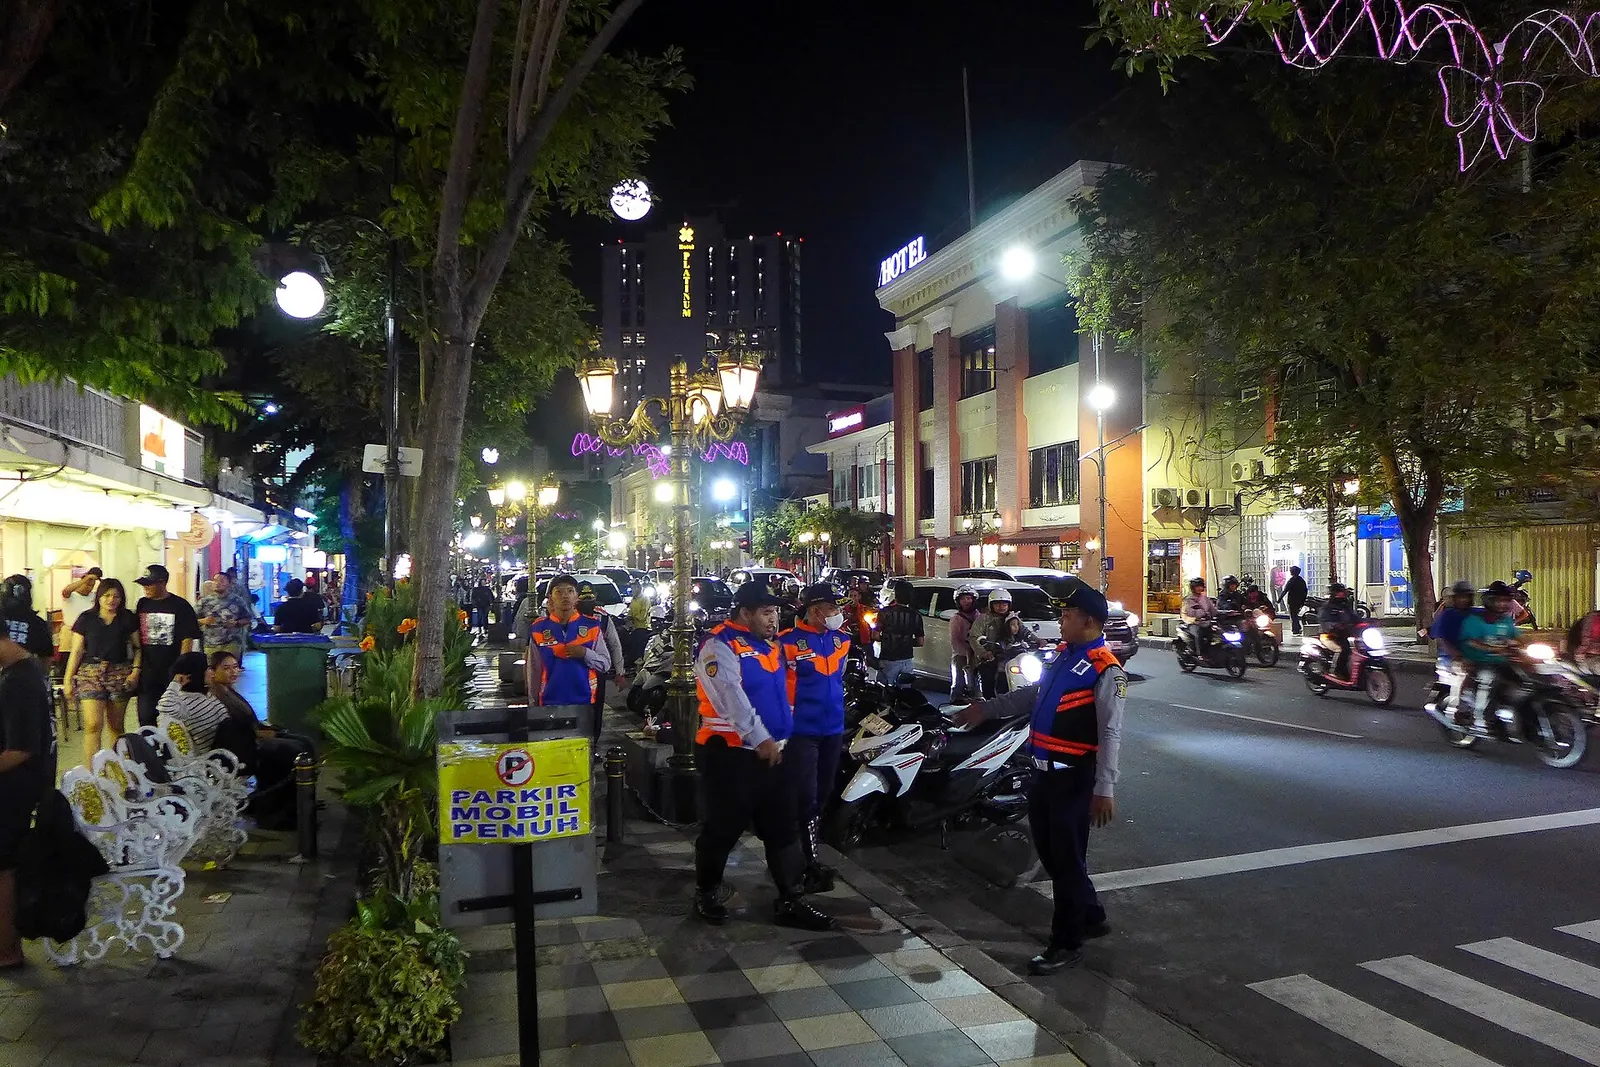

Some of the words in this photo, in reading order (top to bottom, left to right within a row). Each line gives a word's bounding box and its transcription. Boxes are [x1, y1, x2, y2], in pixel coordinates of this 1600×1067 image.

[881, 236, 927, 285] HOTEL
[682, 251, 691, 317] PLATINUM
[451, 784, 577, 804] PARKIR
[450, 802, 579, 821] MOBIL
[452, 816, 579, 838] PENUH
